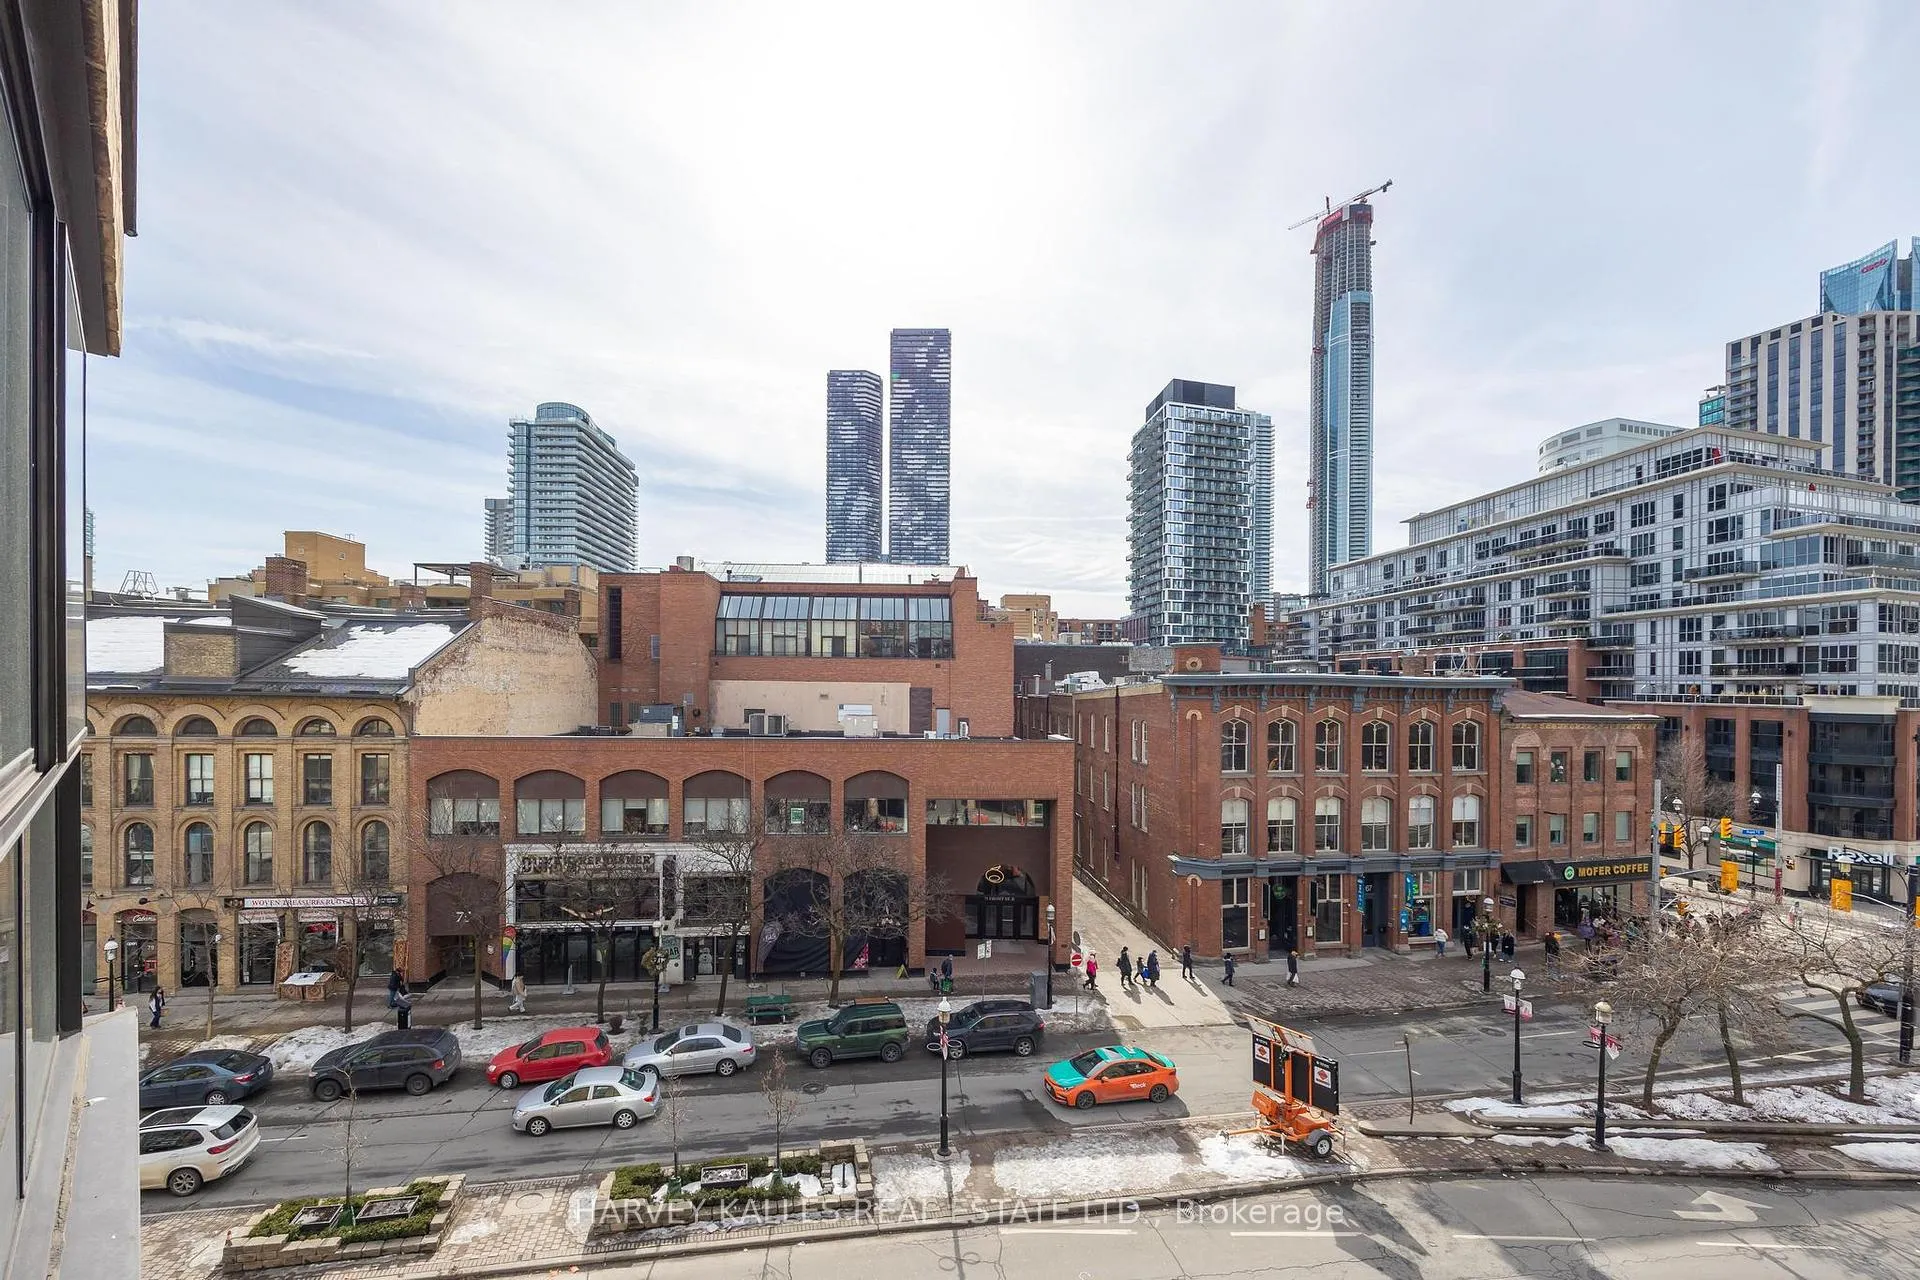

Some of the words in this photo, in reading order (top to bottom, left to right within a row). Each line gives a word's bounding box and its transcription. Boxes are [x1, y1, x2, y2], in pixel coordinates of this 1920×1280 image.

[1828, 846, 1893, 866] Rexall
[1578, 866, 1611, 877] MOFER
[1613, 863, 1649, 875] COFFEE
